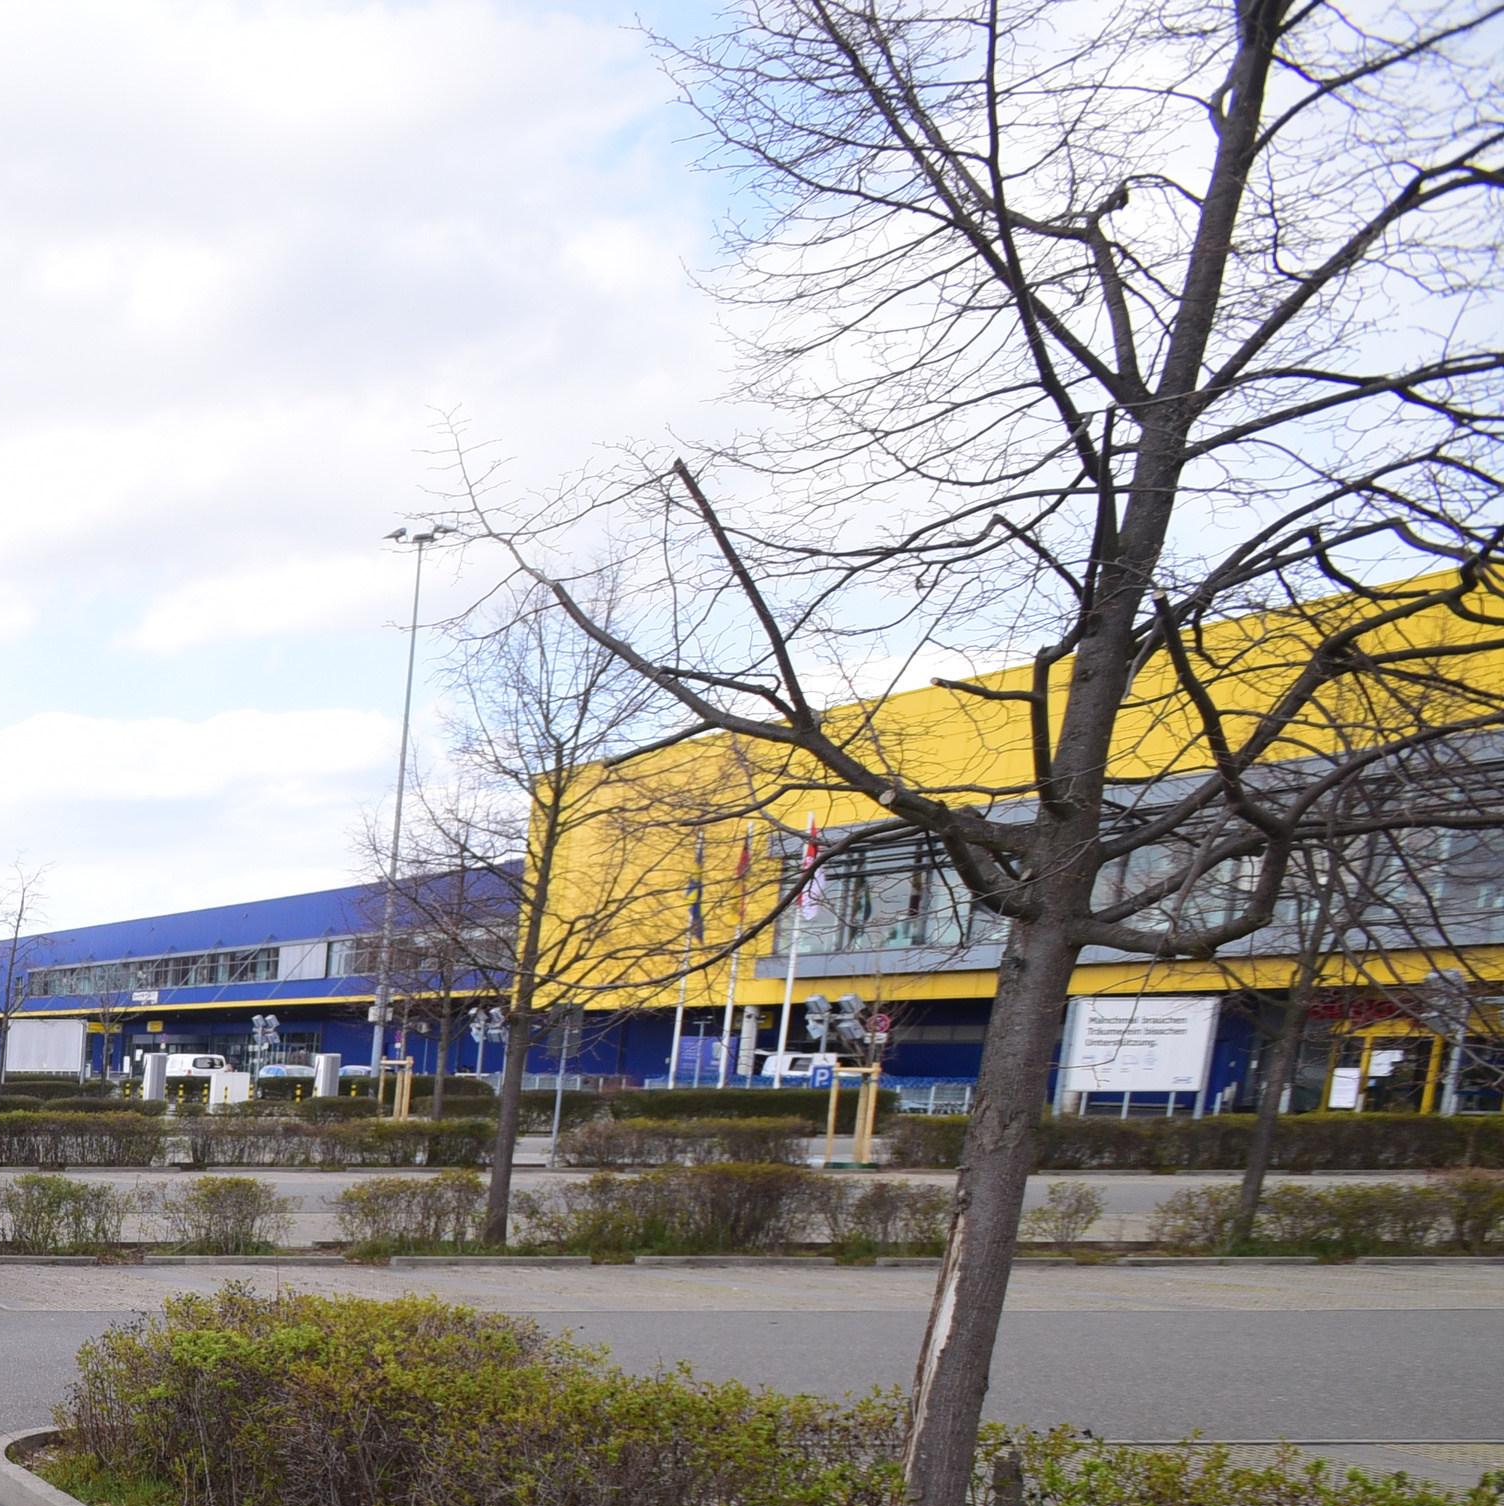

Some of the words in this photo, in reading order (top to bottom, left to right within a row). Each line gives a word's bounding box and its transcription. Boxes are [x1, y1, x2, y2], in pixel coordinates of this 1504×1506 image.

[1141, 1016, 1187, 1024] brauchen
[1143, 1027, 1187, 1036] bisschen
[815, 1068, 830, 1088] P
